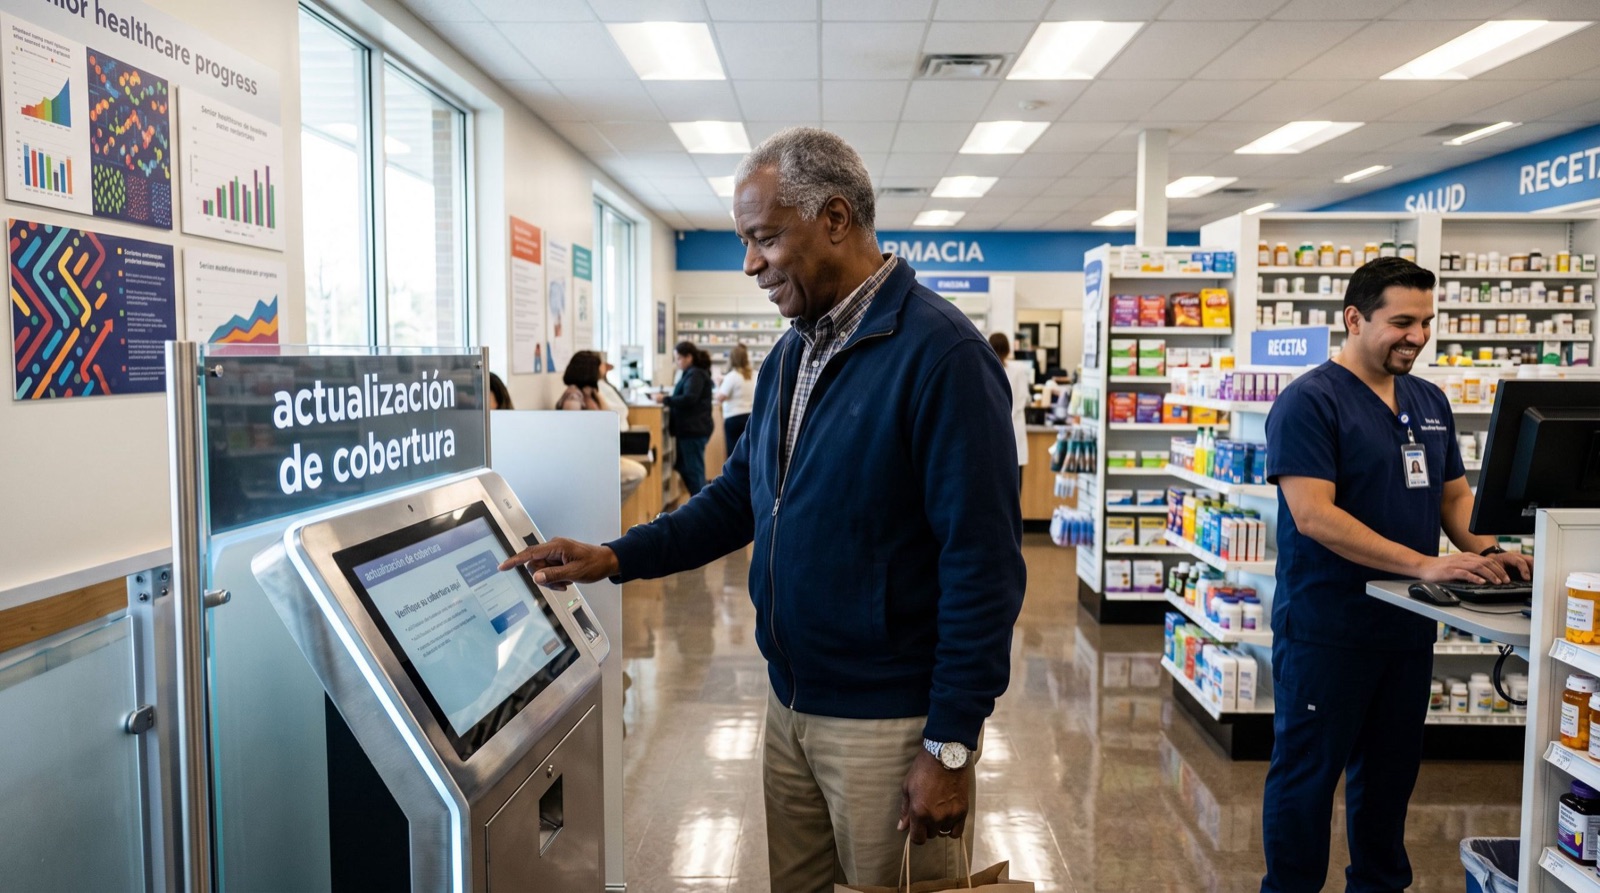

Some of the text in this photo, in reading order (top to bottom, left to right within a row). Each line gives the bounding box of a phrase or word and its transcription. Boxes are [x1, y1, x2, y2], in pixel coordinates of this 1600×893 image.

[95, 0, 190, 65] healthcare
[195, 53, 258, 95] progress
[1519, 147, 1600, 195] RECET
[1405, 183, 1466, 213] SALUD
[882, 240, 985, 263] RMACIA
[1267, 338, 1307, 356] RECETAS
[273, 369, 455, 430] actualización
[279, 428, 455, 495] de cobertura
[405, 553, 415, 565] de
[414, 543, 441, 561] cobertura
